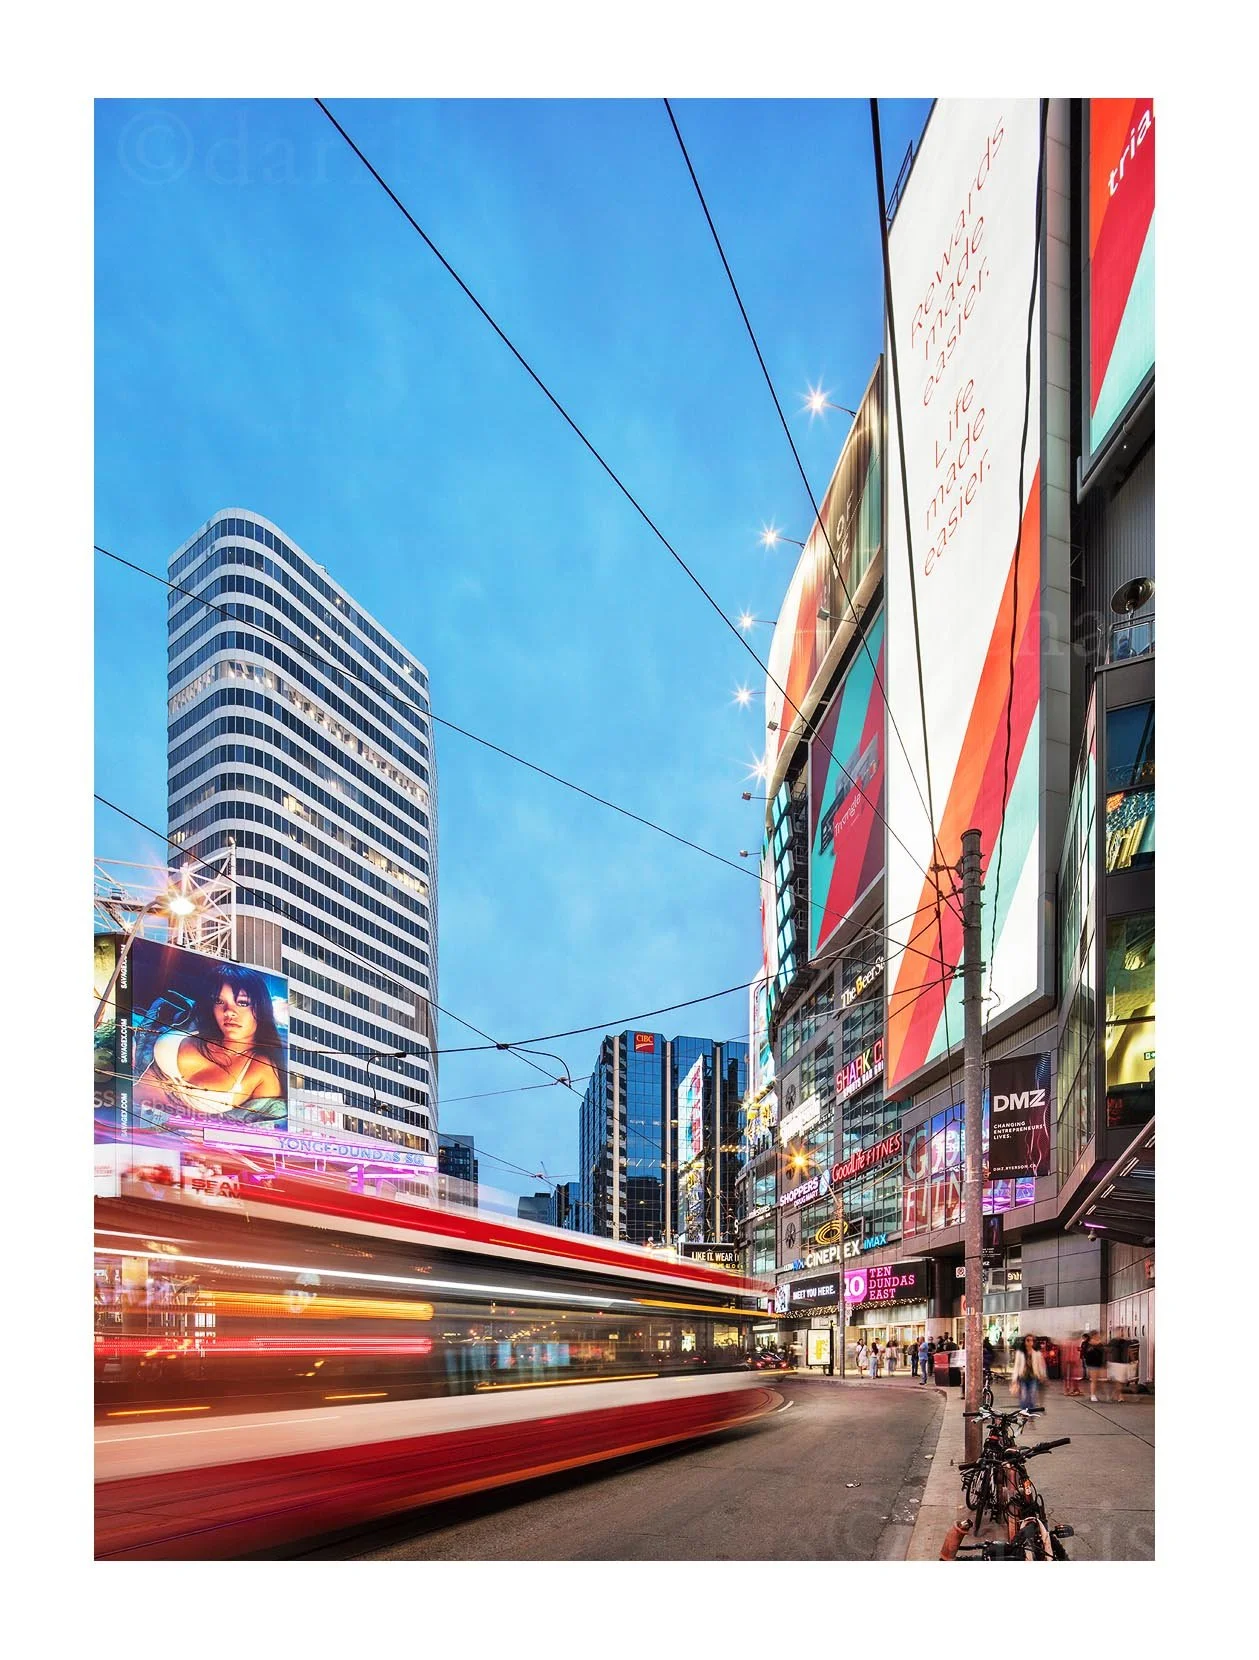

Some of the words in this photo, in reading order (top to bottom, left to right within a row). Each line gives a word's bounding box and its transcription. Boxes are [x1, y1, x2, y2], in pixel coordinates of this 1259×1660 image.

[1108, 109, 1151, 196] tria
[911, 115, 1004, 349] Rewards
[925, 216, 984, 360] made
[924, 256, 989, 406] easier.
[935, 378, 974, 468] Life
[926, 407, 985, 530] made
[924, 449, 990, 576] easier.
[841, 987, 856, 1008] The
[855, 966, 876, 995] Beer
[636, 1034, 653, 1043] CIBC
[836, 1047, 871, 1093] SHARK
[993, 1088, 1045, 1112] DMZ
[993, 1121, 1026, 1129] CHANGING
[866, 1132, 902, 1165] FITNES
[779, 1176, 818, 1206] SHOPPERS
[691, 1251, 706, 1261] LIKE
[715, 1252, 733, 1262] WEAR
[863, 1233, 887, 1250] IMAX
[868, 1275, 915, 1289] DUNDAS
[869, 1266, 892, 1278] TEN
[806, 1287, 817, 1298] YOU
[817, 1285, 836, 1296] HERE.
[869, 1288, 896, 1300] EAST
